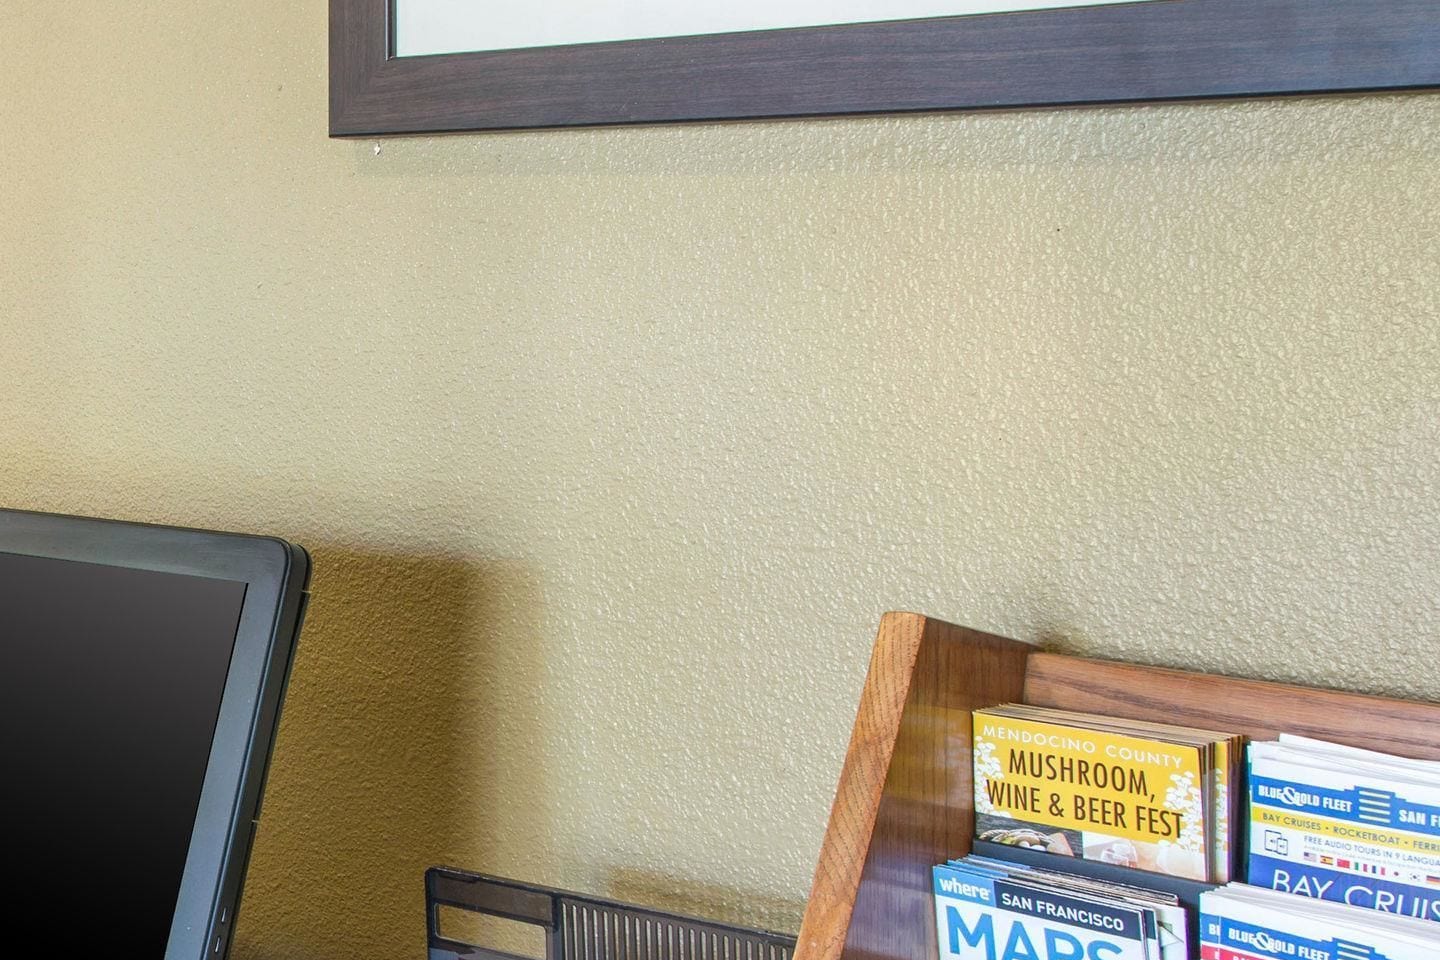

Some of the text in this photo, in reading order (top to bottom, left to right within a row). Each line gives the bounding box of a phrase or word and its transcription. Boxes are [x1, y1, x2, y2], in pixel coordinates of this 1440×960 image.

[983, 724, 1183, 769] MENDOCINO COUNTY
[1009, 748, 1155, 803] MUSHROOM,
[986, 780, 1184, 838] WINE & BEER FEST
[1262, 812, 1280, 823] BAY
[1283, 816, 1322, 831] CRUISES
[1333, 826, 1400, 845] ROCKETBOAT
[1322, 796, 1352, 812] FLEET
[1398, 809, 1426, 826] SAN
[1304, 835, 1322, 846] FREE
[1324, 838, 1352, 851] AUDIO
[1354, 844, 1381, 857] TOURS
[1383, 849, 1393, 858] IN
[1272, 868, 1334, 900] BAY
[939, 876, 1124, 932] where SAN FRANCISCO
